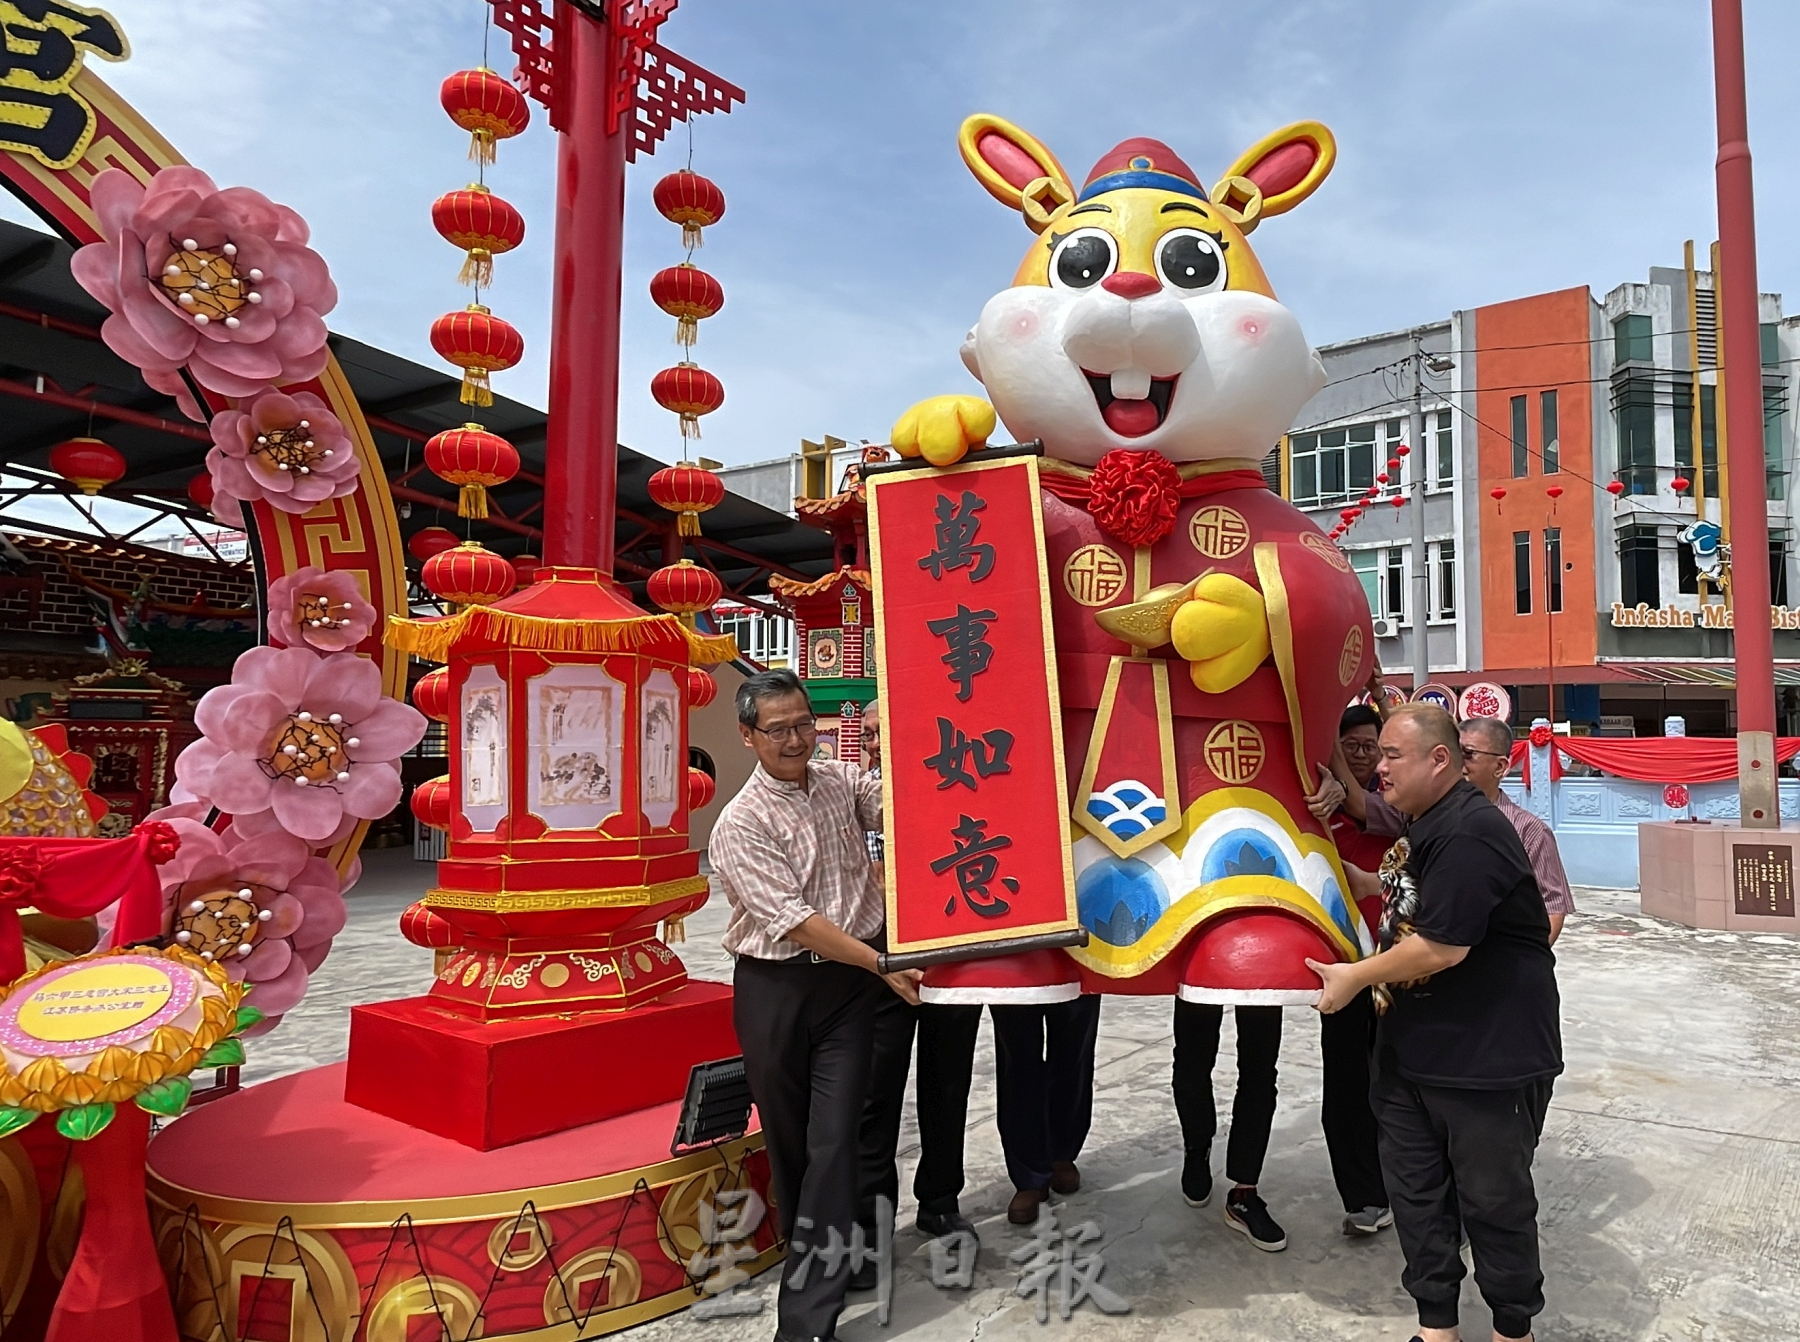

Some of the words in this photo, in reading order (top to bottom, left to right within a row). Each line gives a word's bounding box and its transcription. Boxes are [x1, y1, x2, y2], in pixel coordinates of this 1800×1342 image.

[918, 491, 1020, 917] 萬事如意
[1613, 603, 1694, 627] Infasha
